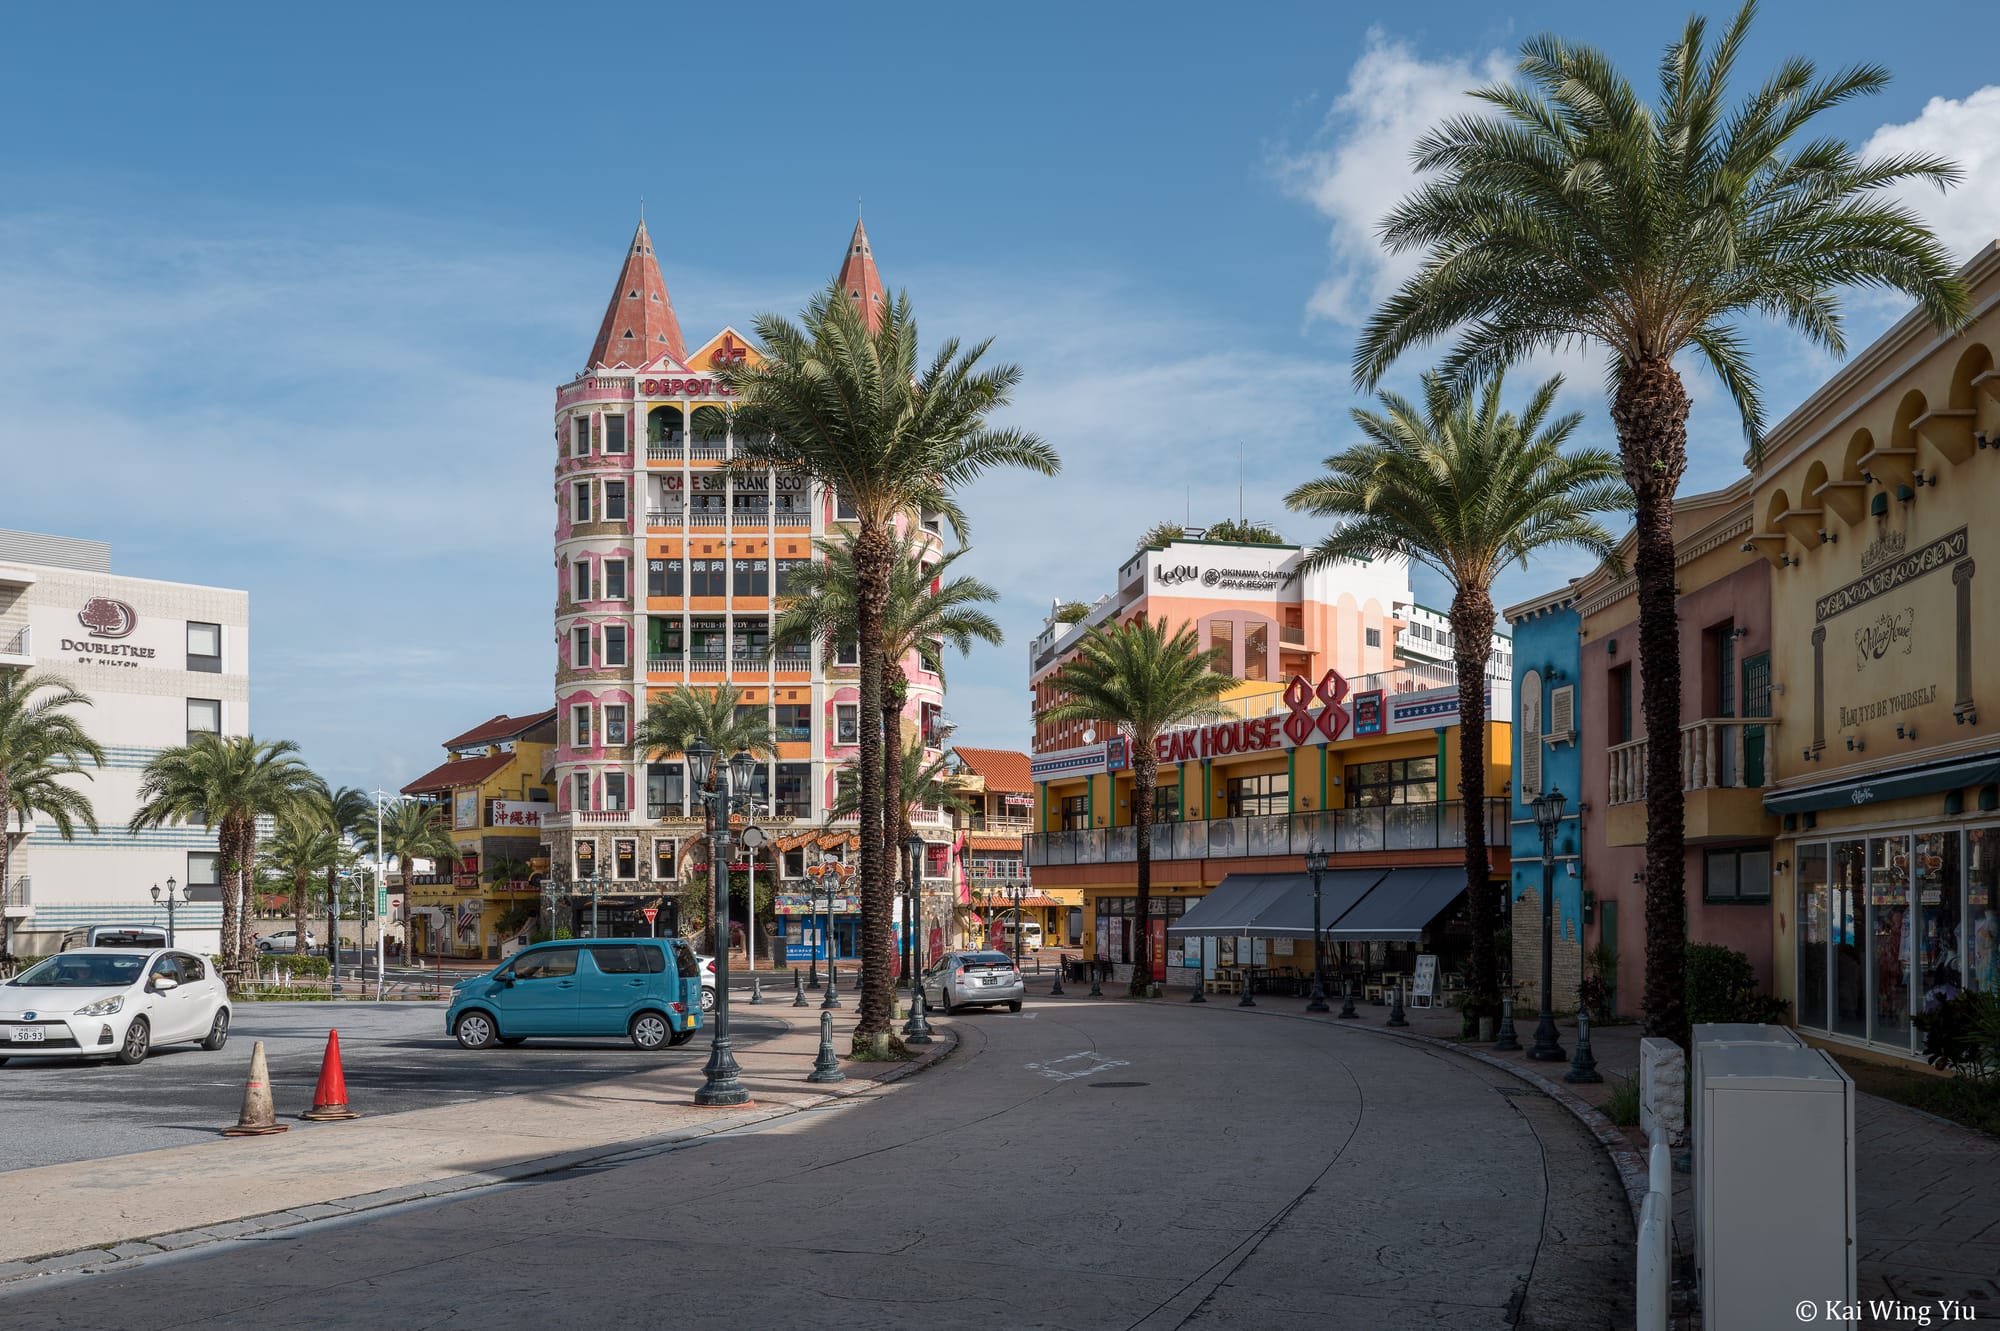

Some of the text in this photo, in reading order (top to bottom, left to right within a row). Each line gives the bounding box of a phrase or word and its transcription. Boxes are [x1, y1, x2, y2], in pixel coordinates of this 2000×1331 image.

[645, 379, 712, 396] DEPOT
[667, 476, 699, 490] CAE
[1221, 568, 1260, 579] OKINAWA
[1222, 579, 1237, 588] SPA
[1247, 581, 1278, 590] RESORT
[98, 659, 138, 668] HILTON
[1877, 700, 1888, 719] BE
[1889, 684, 1937, 714] YOURSELF
[1201, 716, 1281, 758] HOUSE
[1283, 669, 1350, 746] 88
[18, 1032, 43, 1040] 50-93
